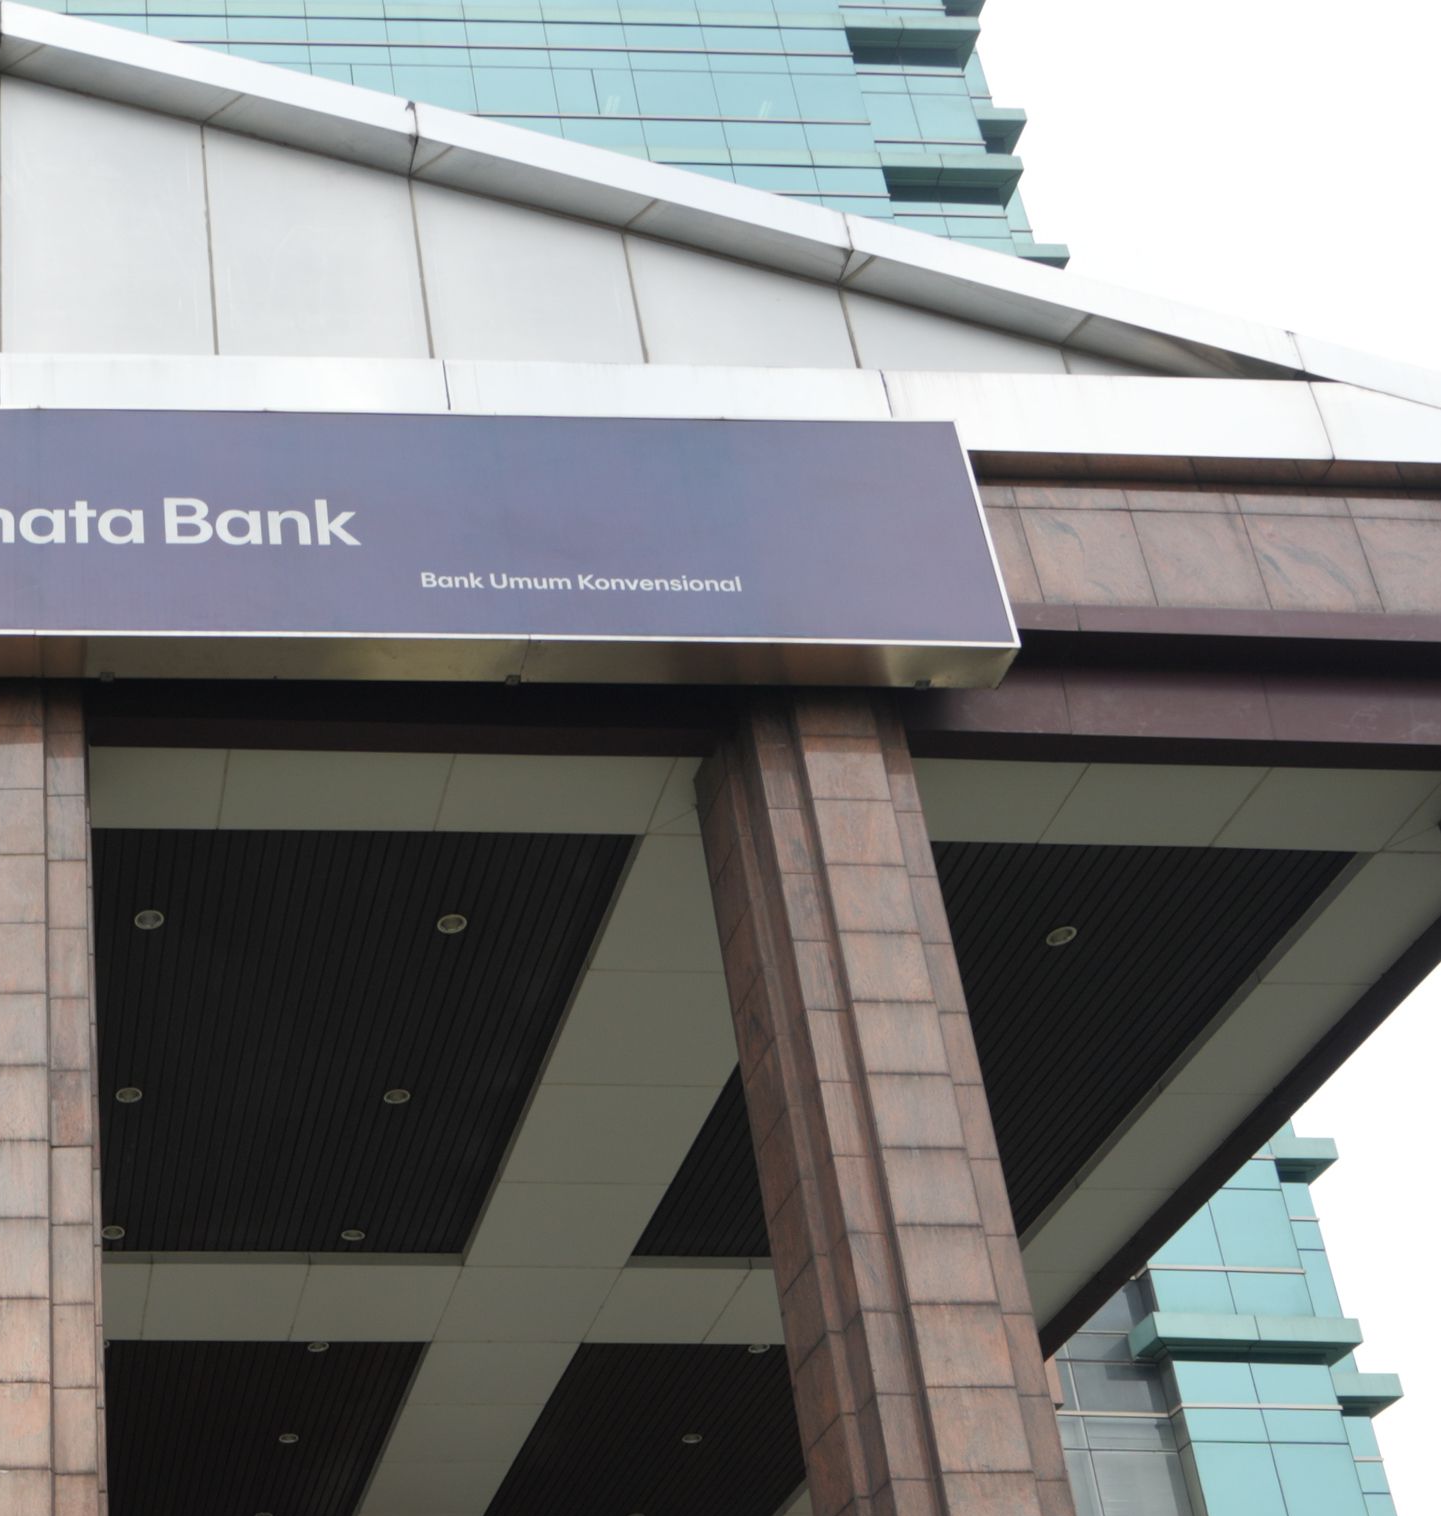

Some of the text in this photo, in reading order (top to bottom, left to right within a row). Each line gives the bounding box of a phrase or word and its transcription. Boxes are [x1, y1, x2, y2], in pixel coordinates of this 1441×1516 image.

[162, 496, 362, 546] Bank
[420, 571, 743, 592] Bank Umum Konvensional
